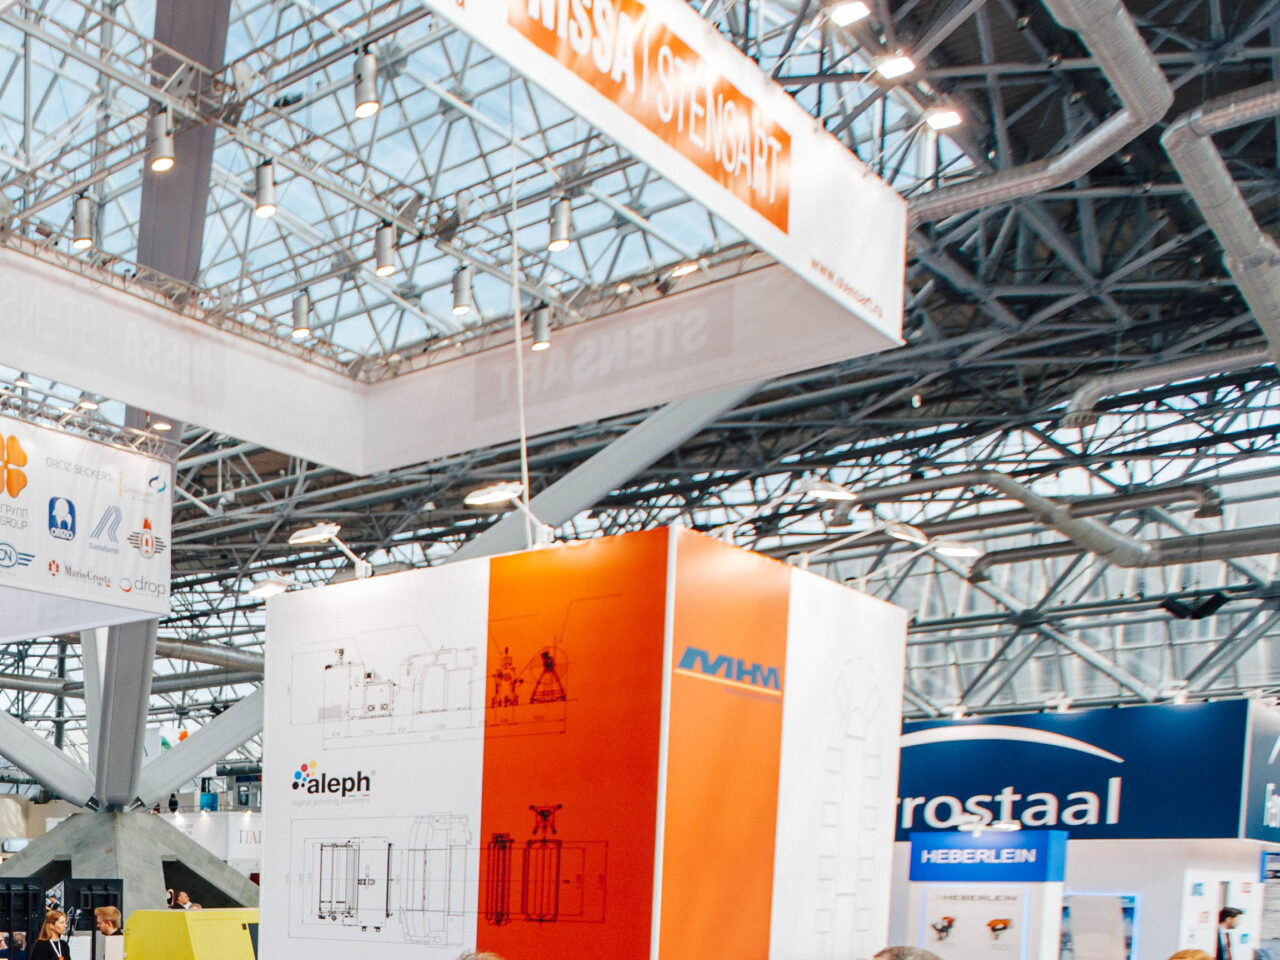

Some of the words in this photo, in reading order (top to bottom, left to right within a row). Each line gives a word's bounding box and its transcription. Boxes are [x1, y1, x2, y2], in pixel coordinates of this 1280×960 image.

[657, 45, 782, 204] STENSART
[134, 576, 166, 596] drop
[677, 645, 780, 690] MHM
[307, 771, 370, 797] aleph
[897, 777, 1122, 829] rostaal
[921, 849, 1037, 864] HEBERLEIN
